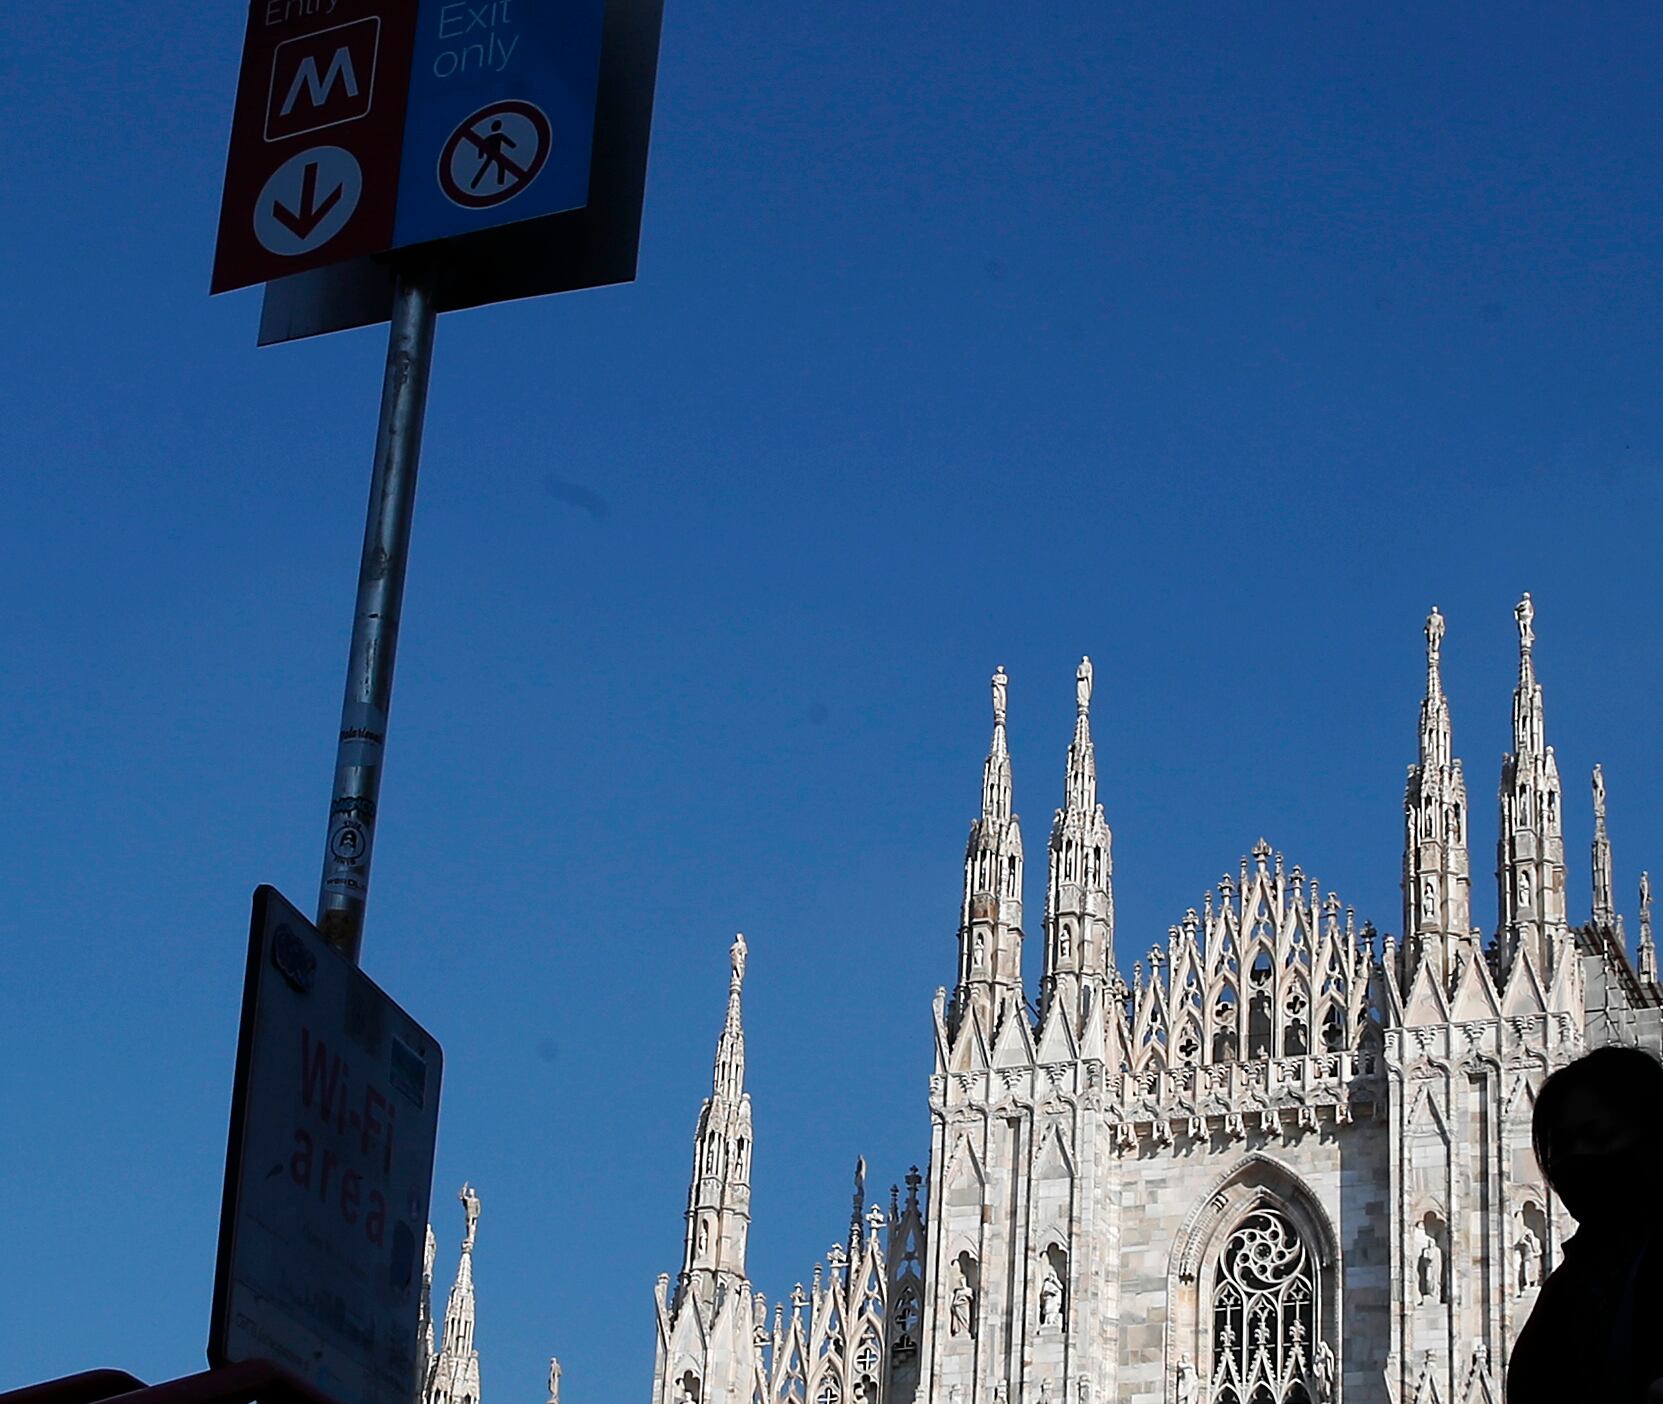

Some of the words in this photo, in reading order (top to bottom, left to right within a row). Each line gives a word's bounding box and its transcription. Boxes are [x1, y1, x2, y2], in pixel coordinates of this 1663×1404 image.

[432, 31, 520, 78] only
[438, 0, 512, 40] Exit
[301, 1027, 395, 1176] Wi-Fi
[290, 1128, 385, 1248] area
